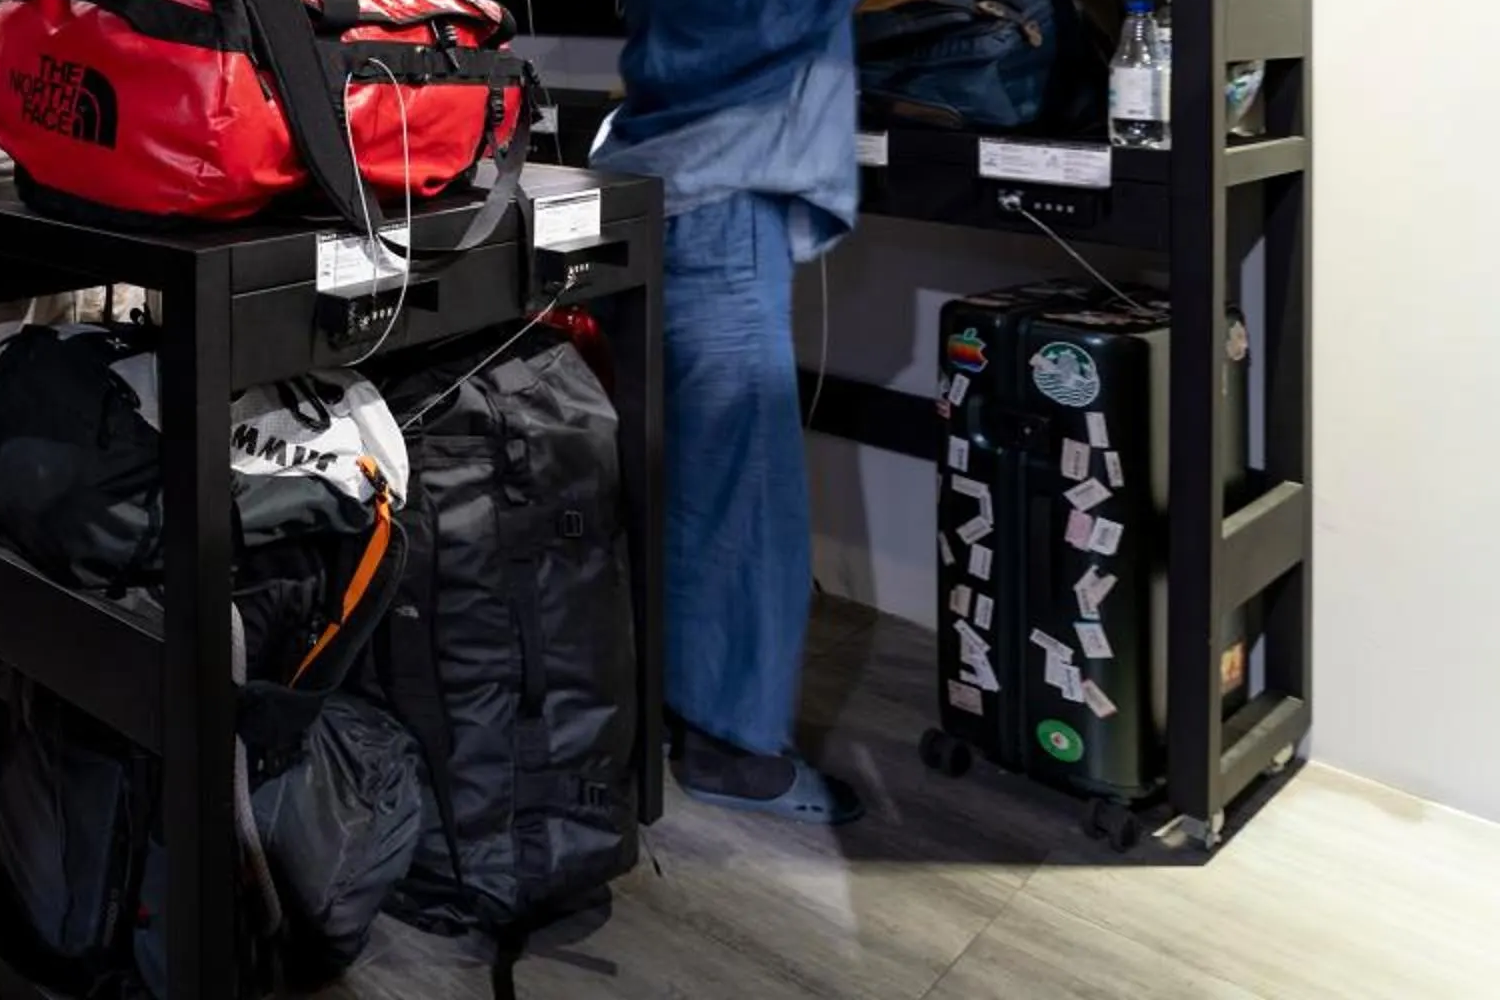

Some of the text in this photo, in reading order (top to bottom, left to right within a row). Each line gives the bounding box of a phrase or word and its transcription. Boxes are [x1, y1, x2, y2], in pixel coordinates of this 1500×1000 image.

[41, 55, 81, 83] THE
[10, 71, 78, 110] NORTH
[23, 98, 71, 134] FACE
[233, 424, 337, 471] MMUT
